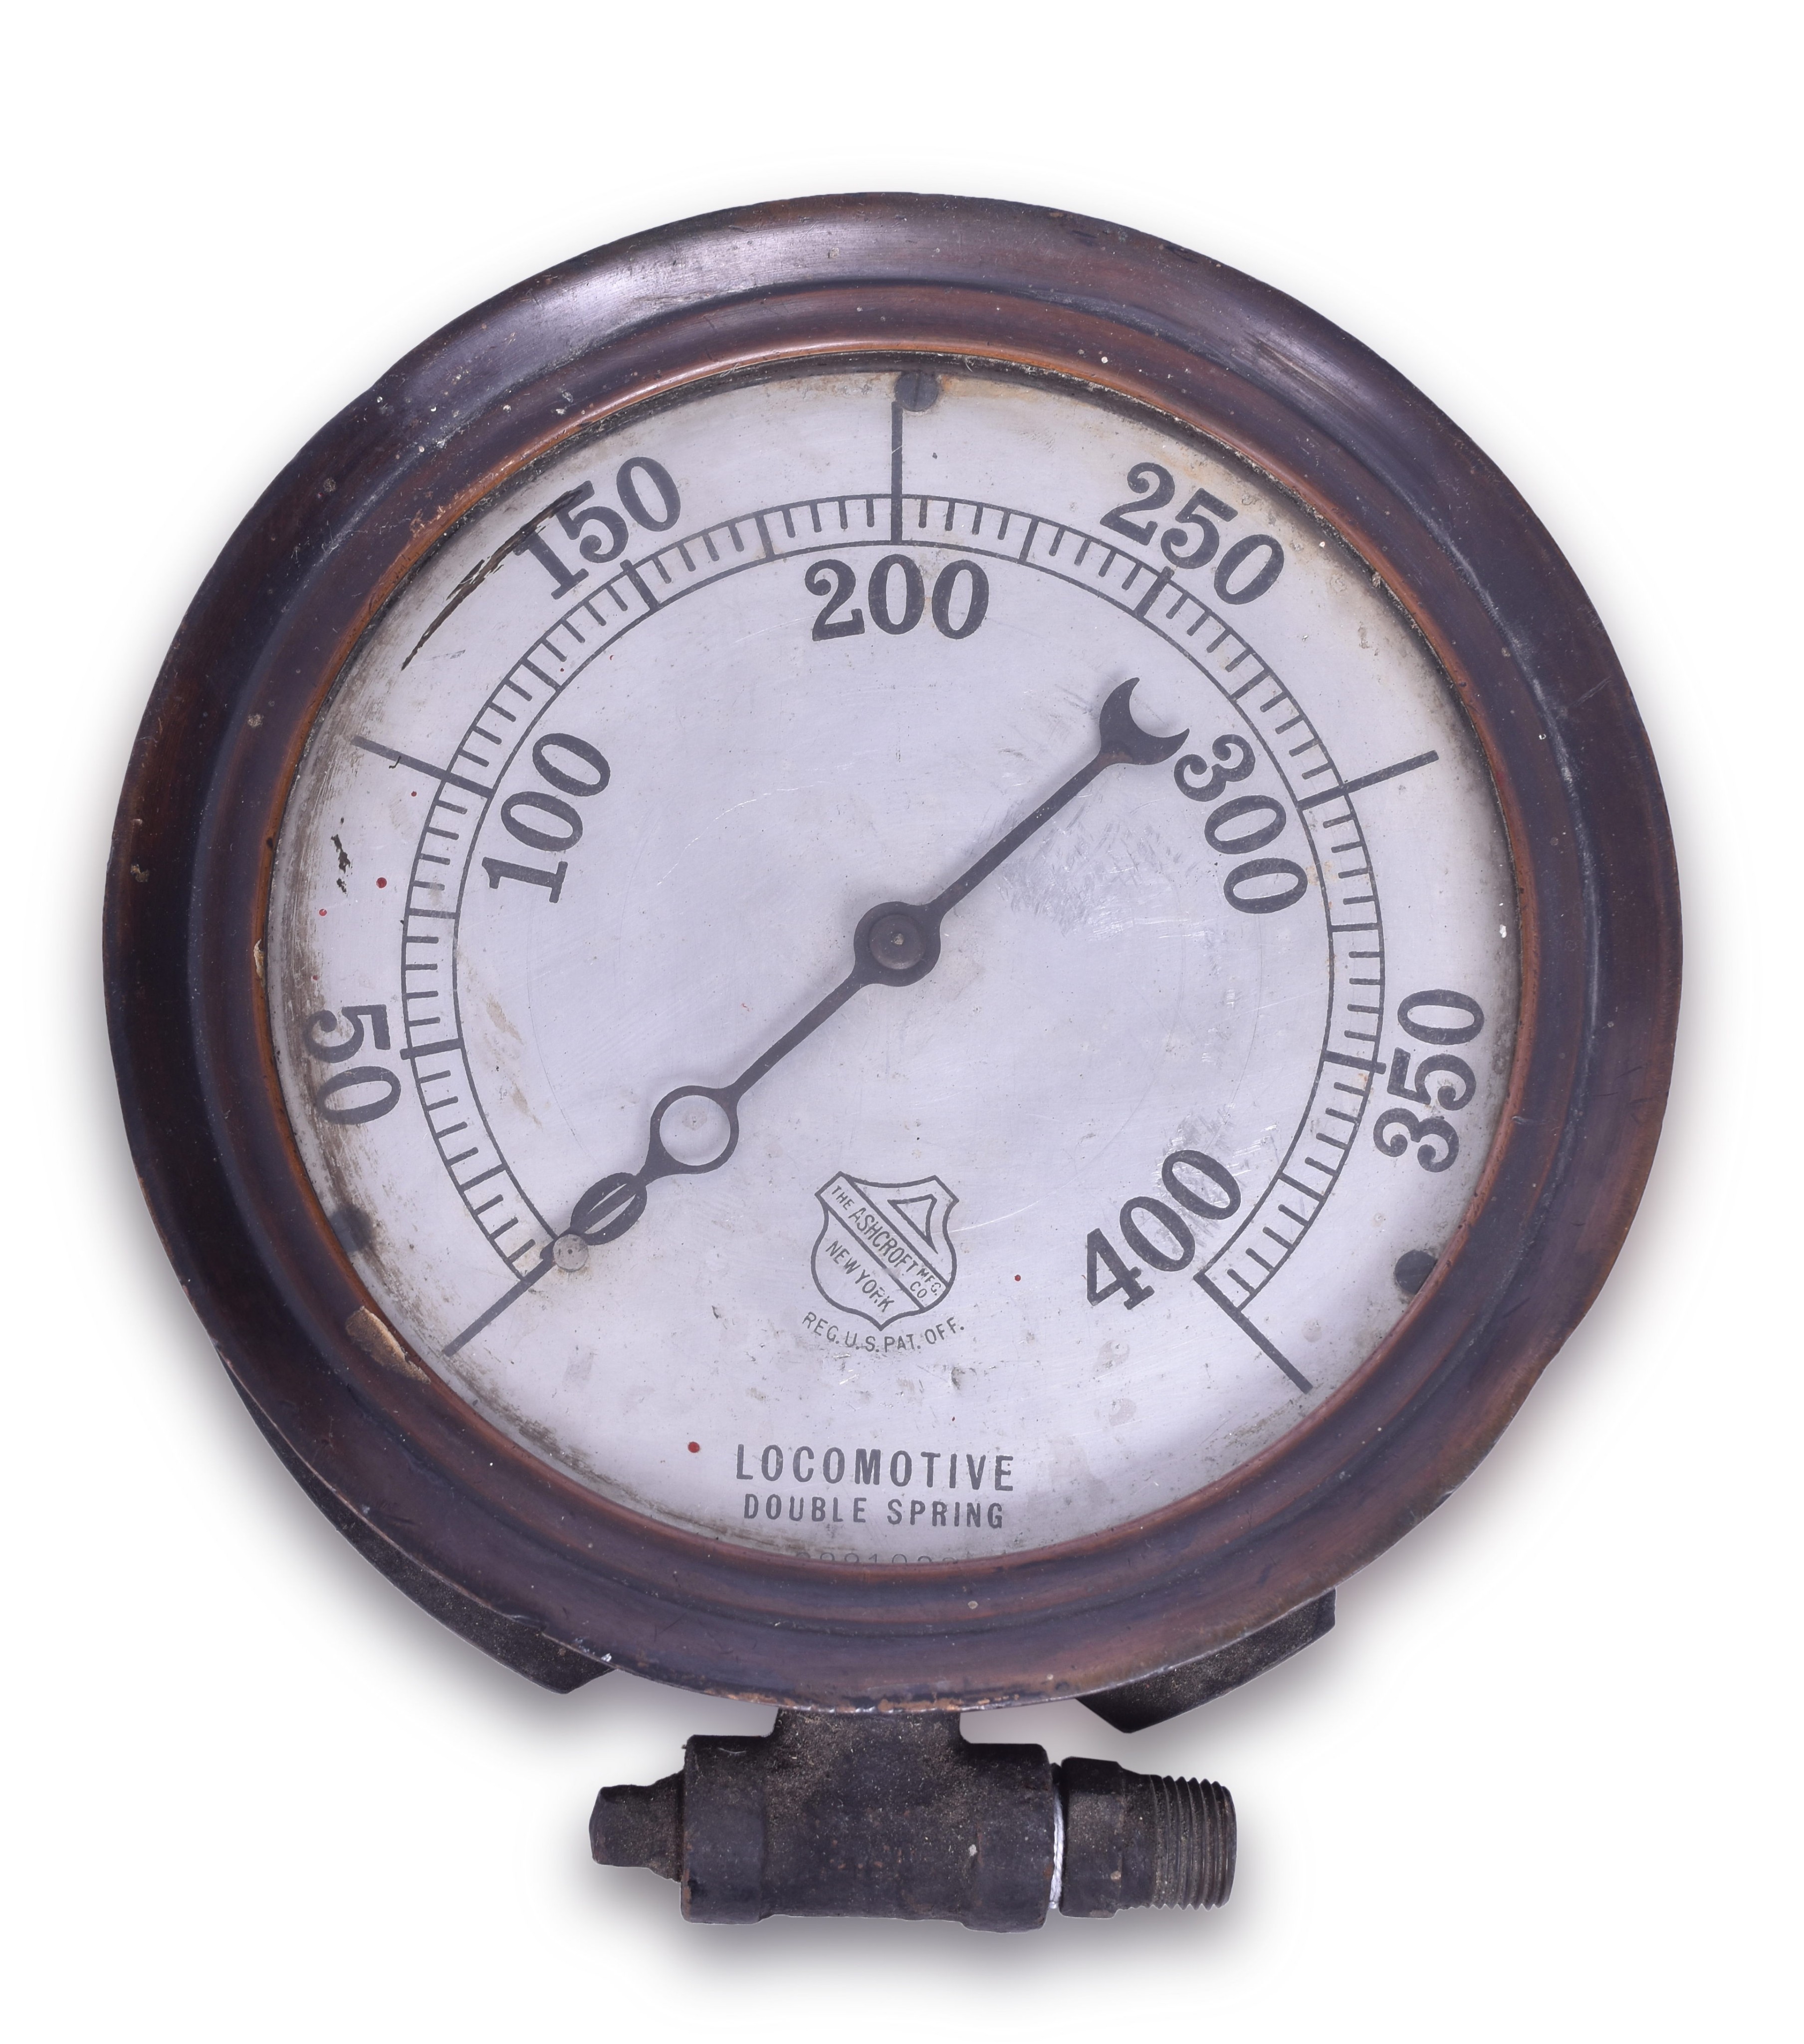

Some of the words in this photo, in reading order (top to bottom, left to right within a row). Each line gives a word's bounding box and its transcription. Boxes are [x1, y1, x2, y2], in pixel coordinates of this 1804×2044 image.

[513, 457, 681, 600] 150
[1100, 462, 1285, 605] 250
[804, 553, 989, 642] 200
[481, 733, 611, 904] 100
[1173, 734, 1308, 914] 300
[301, 1004, 402, 1130] 50
[1373, 989, 1485, 1173] 350
[825, 1240, 861, 1275] NEW
[855, 1269, 895, 1313] YORK
[831, 1185, 855, 1211] THE
[848, 1207, 918, 1273] ASHCROFT
[916, 1268, 941, 1296] MFG.
[1085, 1149, 1241, 1310] 400
[924, 1317, 965, 1344] OFF.
[736, 1444, 1014, 1492] LOCOMOTIVE
[744, 1494, 867, 1523] DOUBLE
[887, 1499, 1003, 1529] SPRING
